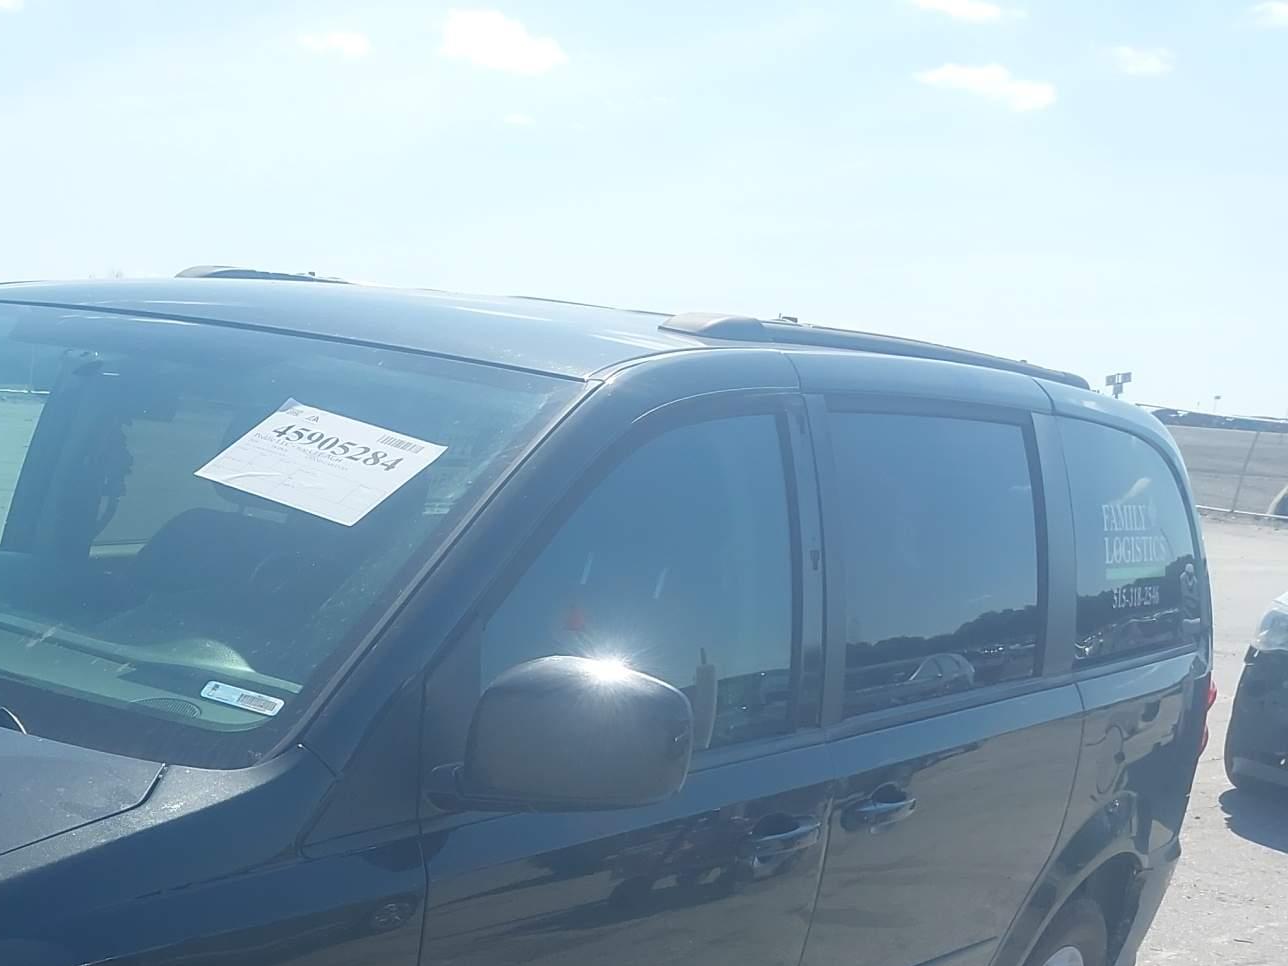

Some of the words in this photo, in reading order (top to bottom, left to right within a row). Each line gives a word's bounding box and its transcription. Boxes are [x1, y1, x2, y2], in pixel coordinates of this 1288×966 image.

[272, 424, 404, 472] 45905284
[1102, 504, 1147, 531] FAMILY
[1103, 535, 1167, 564] LOGISTICS
